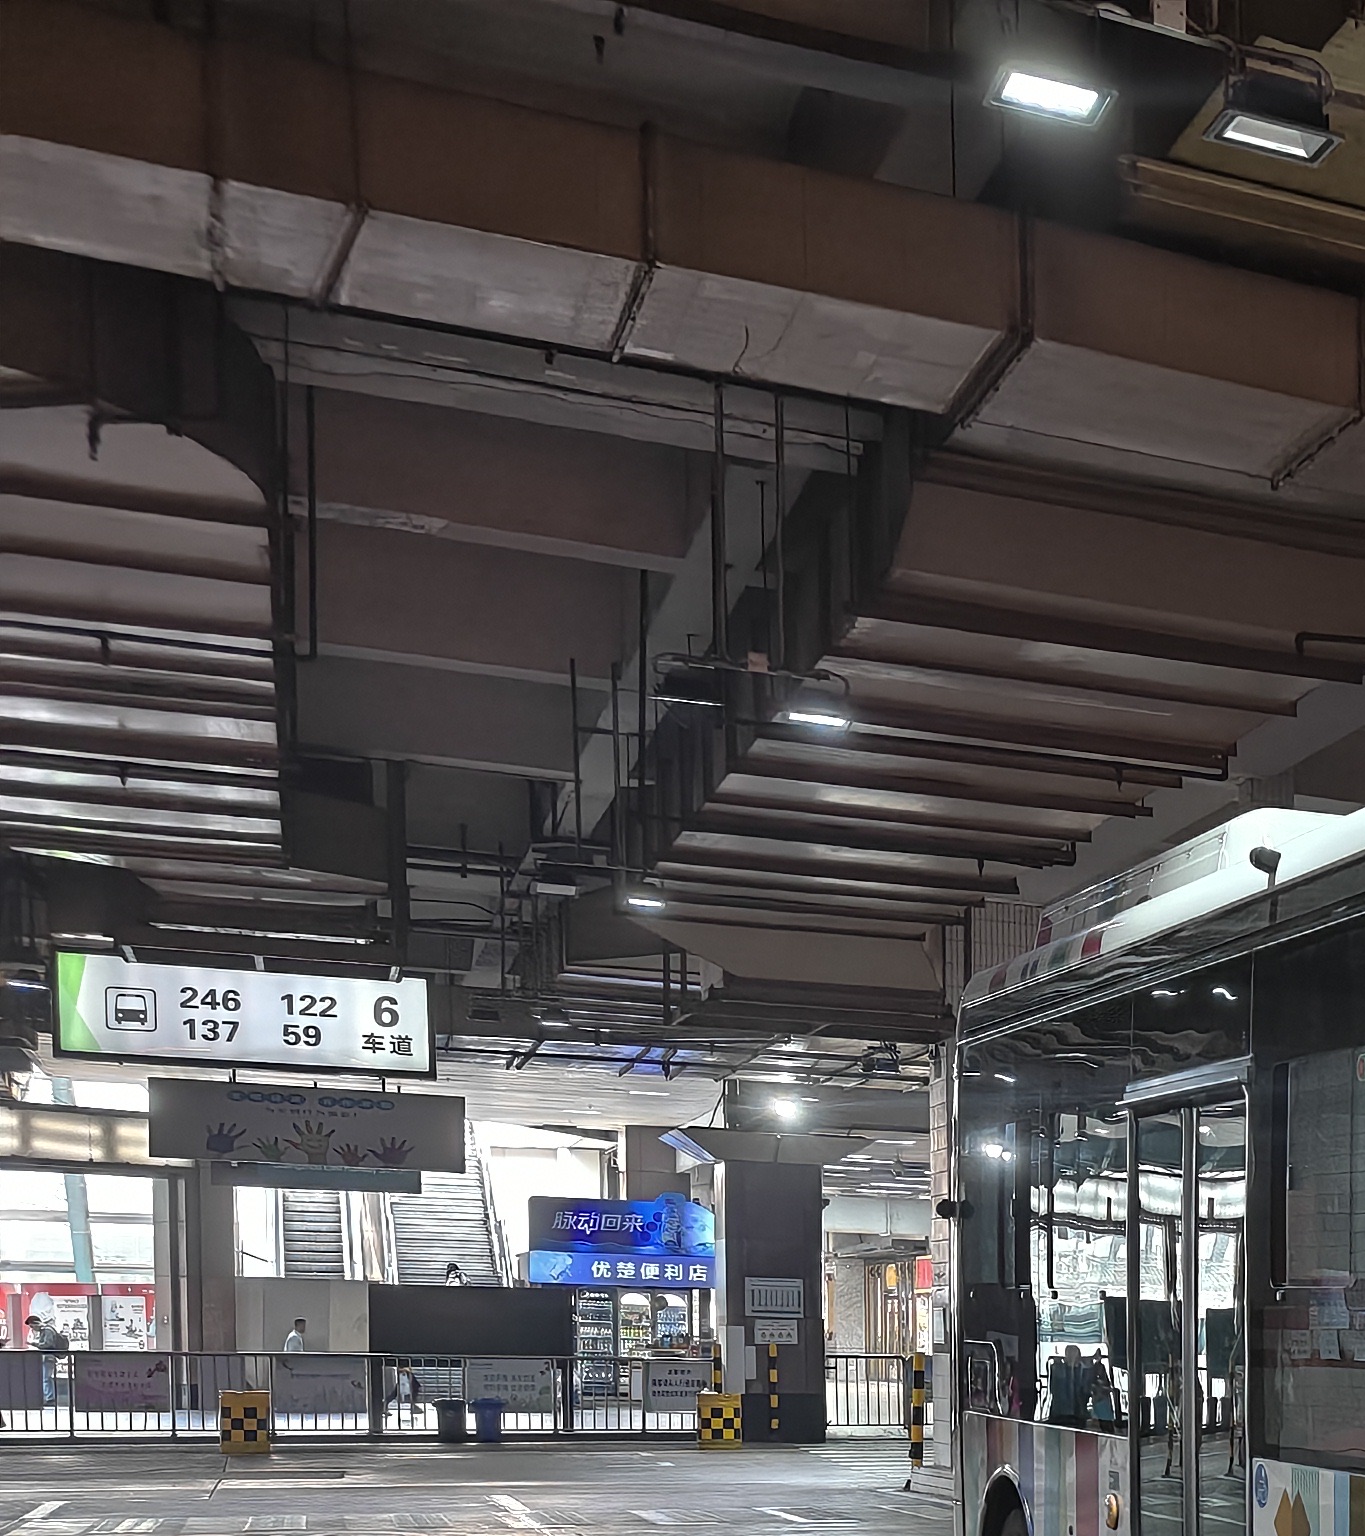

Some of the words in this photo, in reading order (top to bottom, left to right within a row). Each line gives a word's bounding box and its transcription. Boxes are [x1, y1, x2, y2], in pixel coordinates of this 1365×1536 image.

[179, 986, 242, 1012] 246
[280, 993, 339, 1018] 122
[373, 995, 400, 1028] 6
[182, 1018, 240, 1043] 137
[282, 1023, 323, 1047] 59
[361, 1032, 414, 1057] 车道
[551, 1211, 645, 1235] 脉动回来
[591, 1260, 709, 1282] 优楚便利店
